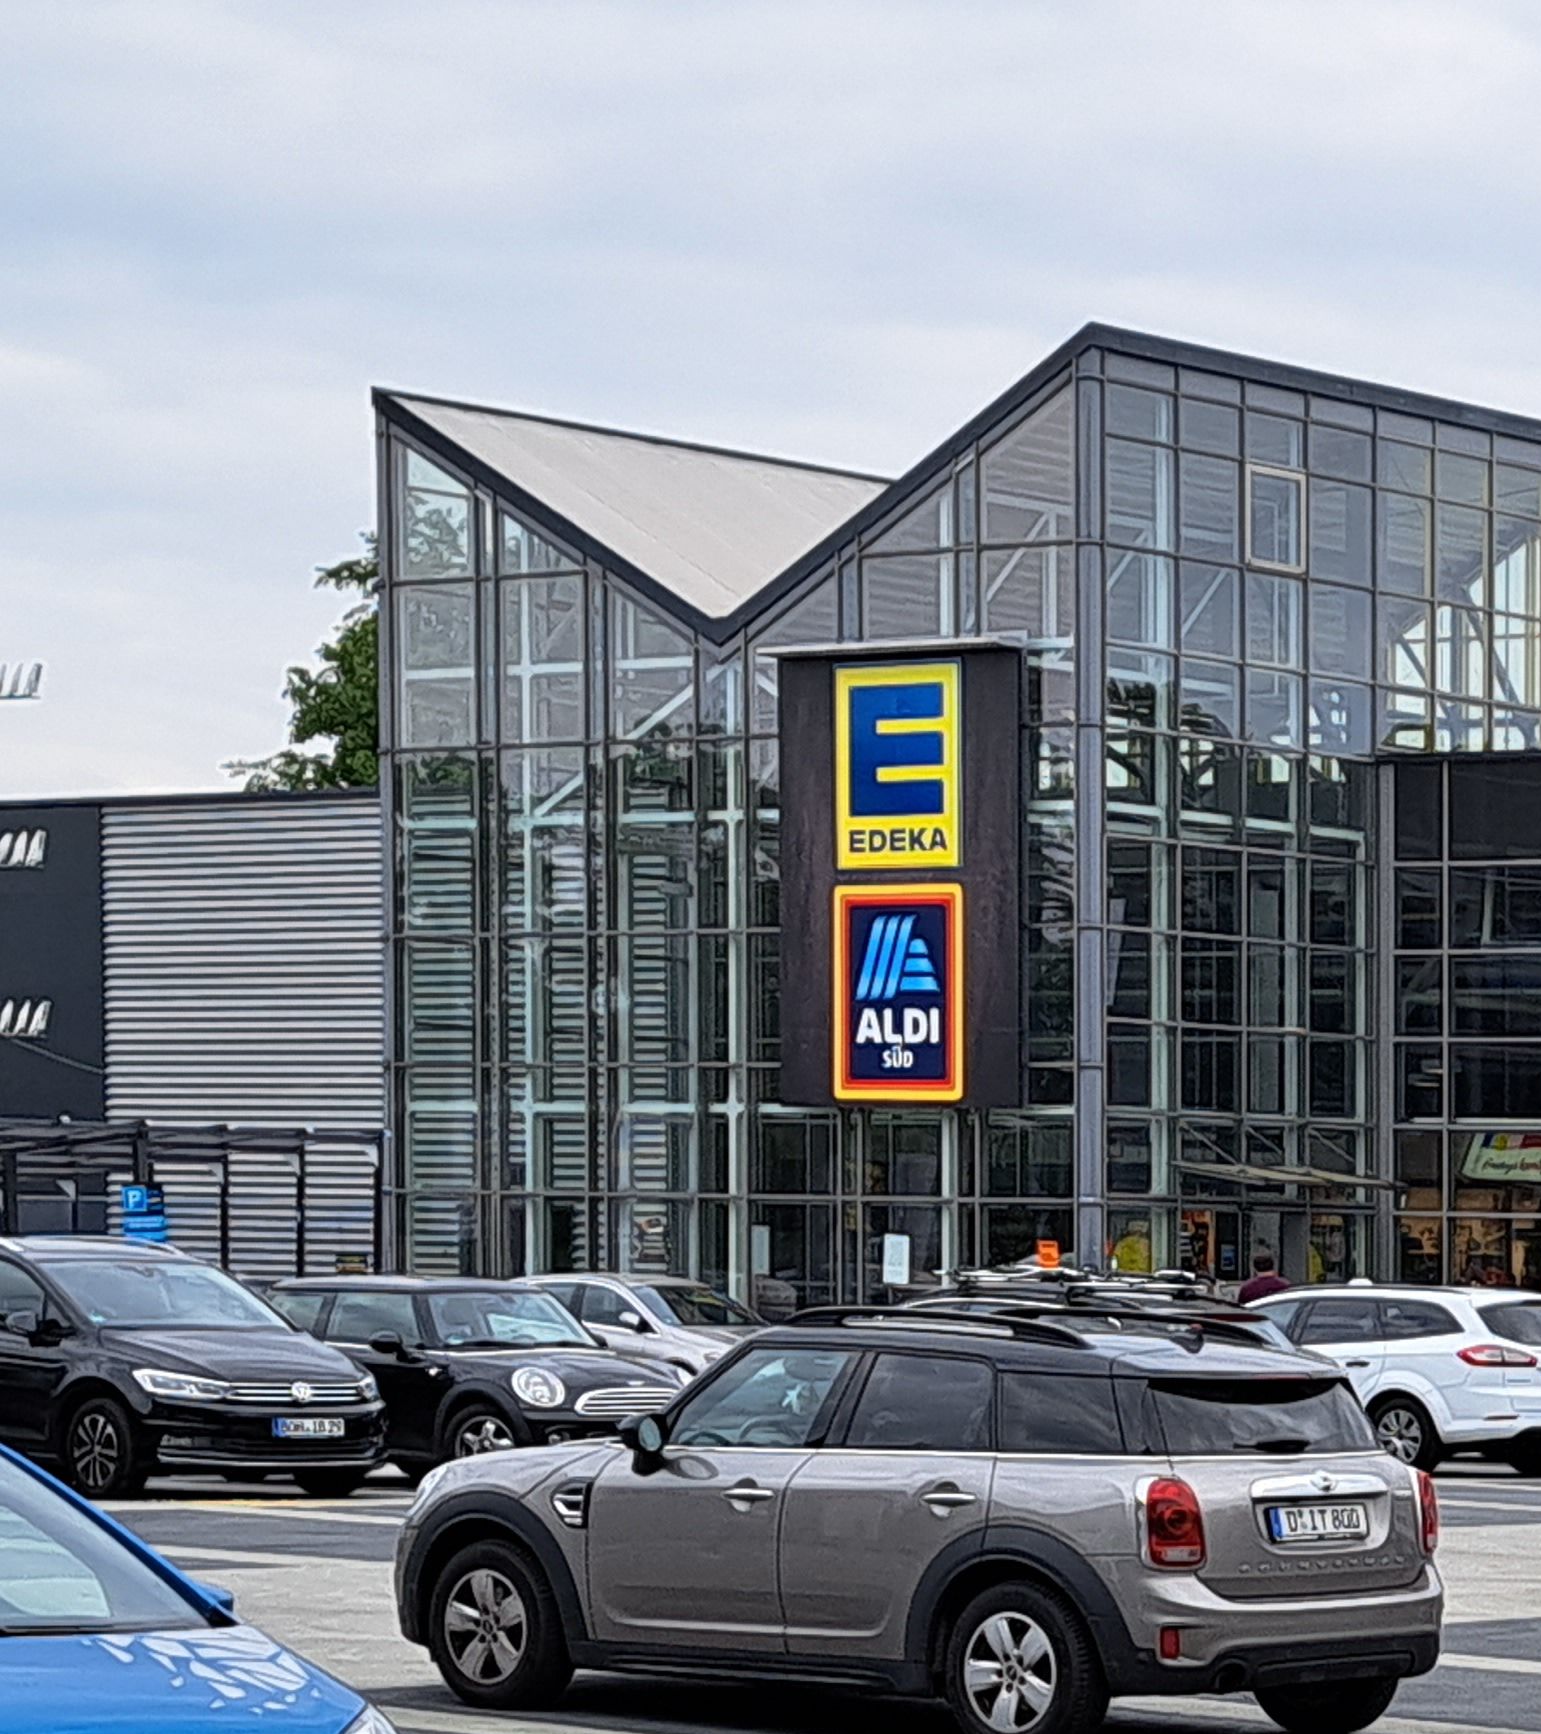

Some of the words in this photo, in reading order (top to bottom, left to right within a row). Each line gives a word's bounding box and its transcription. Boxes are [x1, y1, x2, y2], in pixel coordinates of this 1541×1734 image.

[850, 682, 944, 817] E
[849, 828, 948, 853] EDEKA
[855, 1007, 940, 1044] ALDI
[881, 1045, 914, 1069] SÜD
